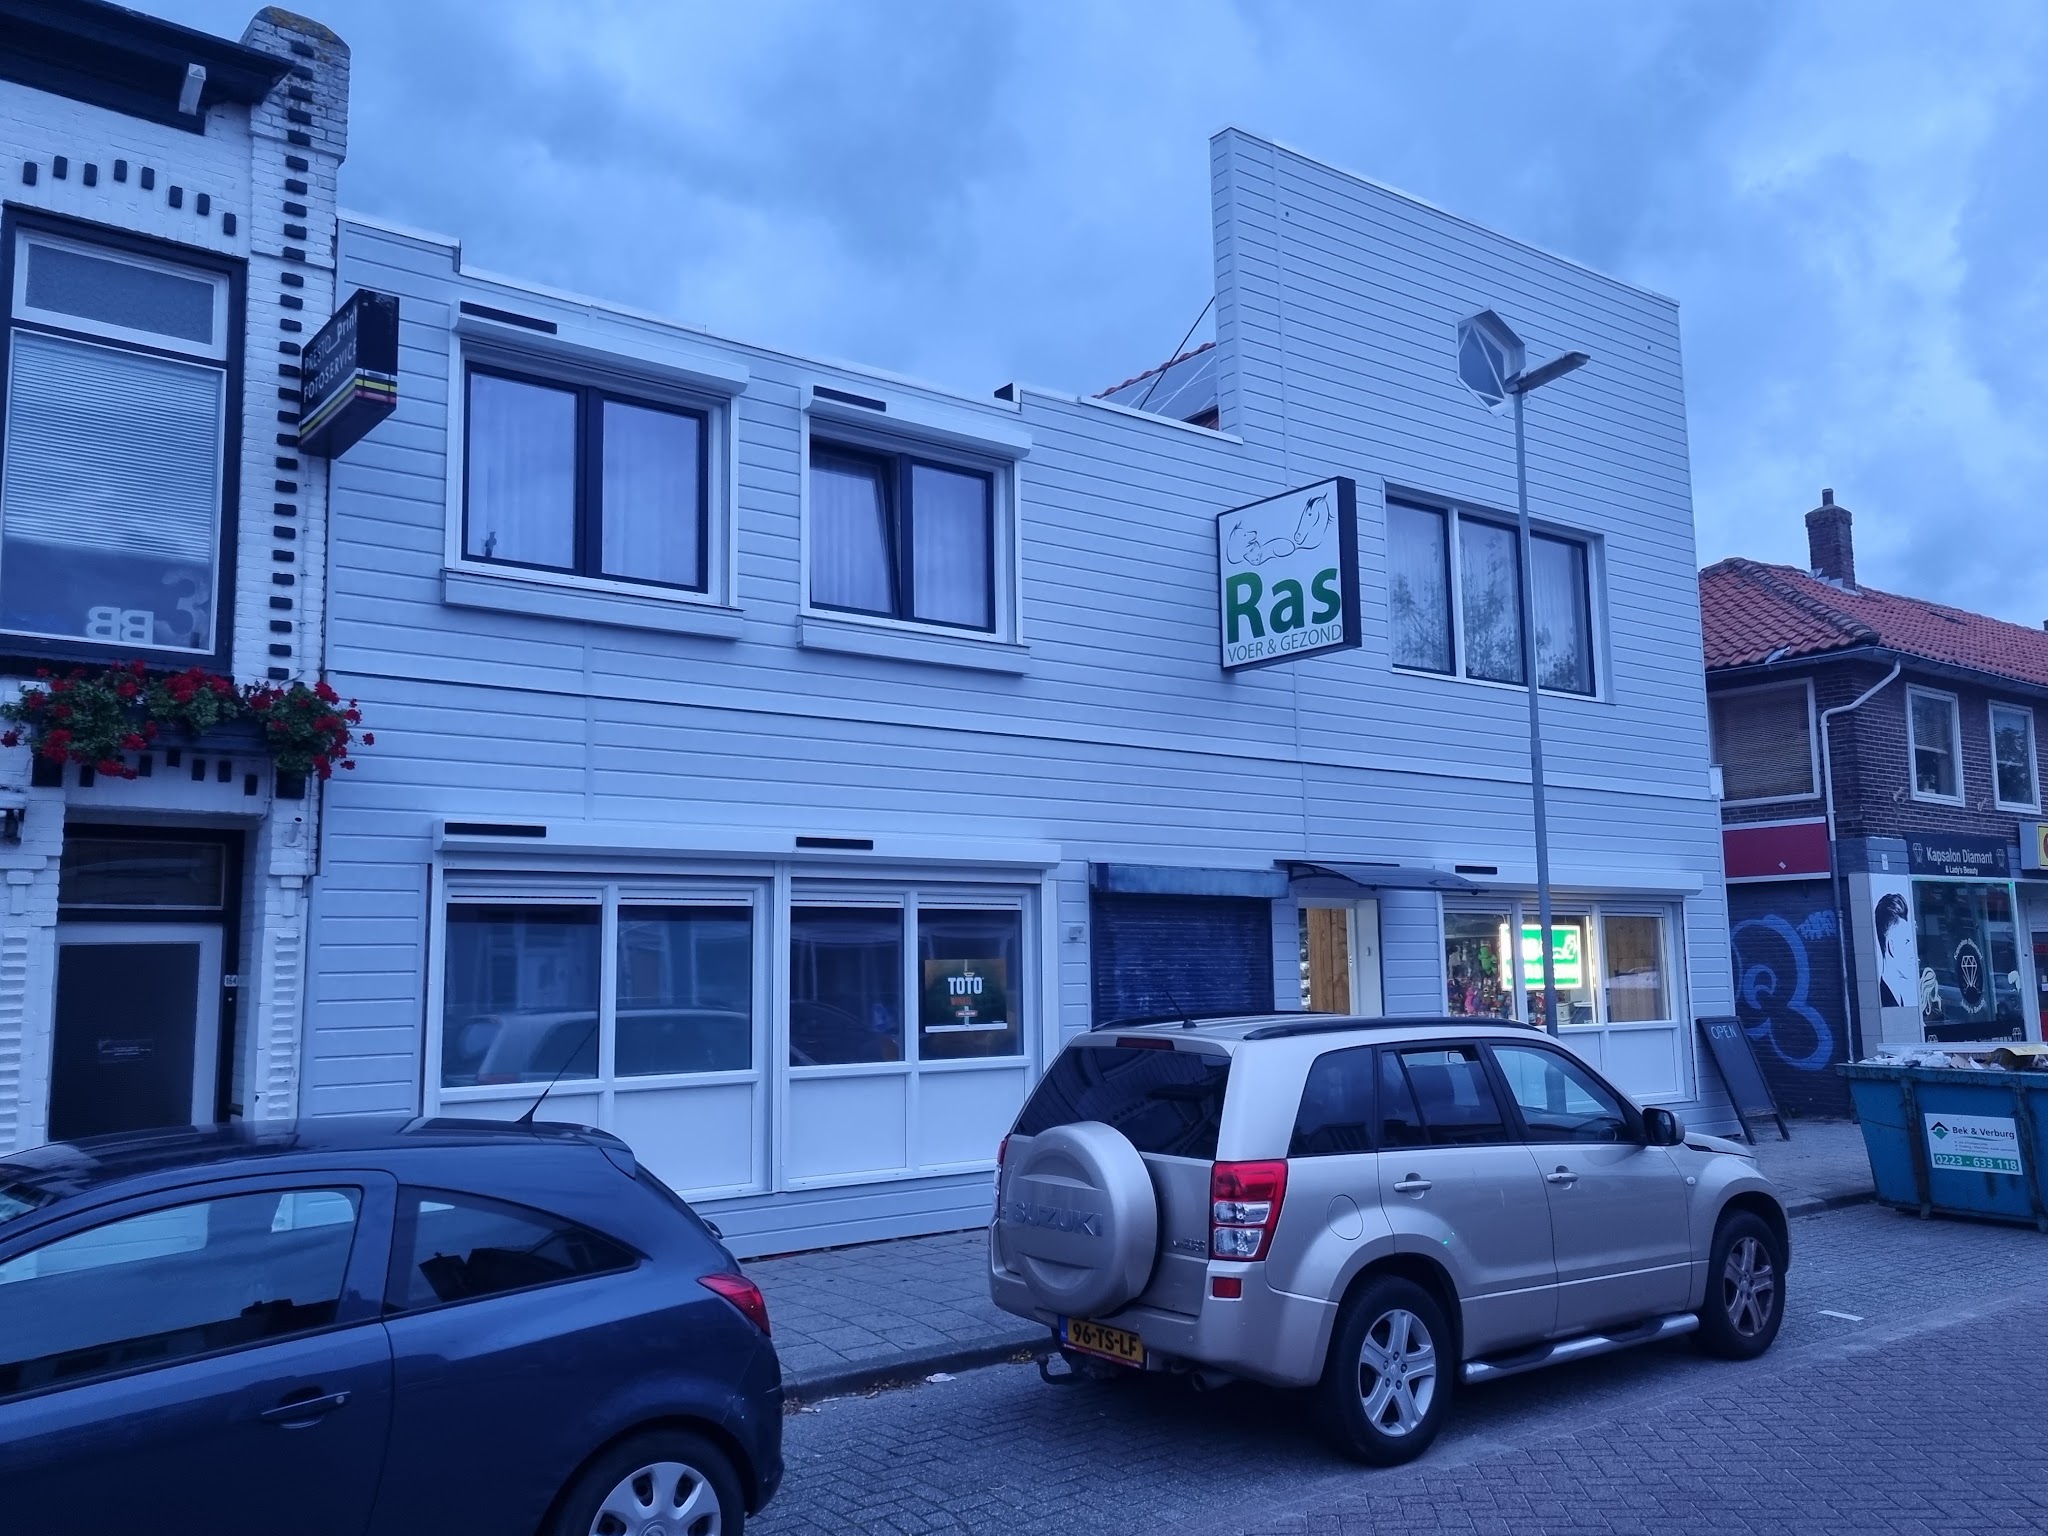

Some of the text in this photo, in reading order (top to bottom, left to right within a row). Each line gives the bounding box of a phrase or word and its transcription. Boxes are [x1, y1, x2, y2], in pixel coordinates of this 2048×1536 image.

[304, 335, 332, 375] PRESTO
[303, 337, 358, 404] FOTOSERVICE
[1226, 568, 1341, 645] Ras
[1228, 624, 1342, 662] VOER & GEZOND
[1926, 847, 1993, 865] Kapsalon Diamant
[1949, 866, 1963, 875] Lady's
[1963, 866, 1979, 876] Beauty
[947, 977, 983, 995] TOTO
[1710, 1025, 1737, 1039] OPEN
[1952, 1126, 2015, 1139] Bek & Verburg
[1936, 1154, 1962, 1166] 0223
[1973, 1157, 1993, 1168] 633
[1997, 1160, 2017, 1170] 118
[1013, 1200, 1103, 1237] SUZUKI
[1073, 1323, 1137, 1356] 96-TS-LF
